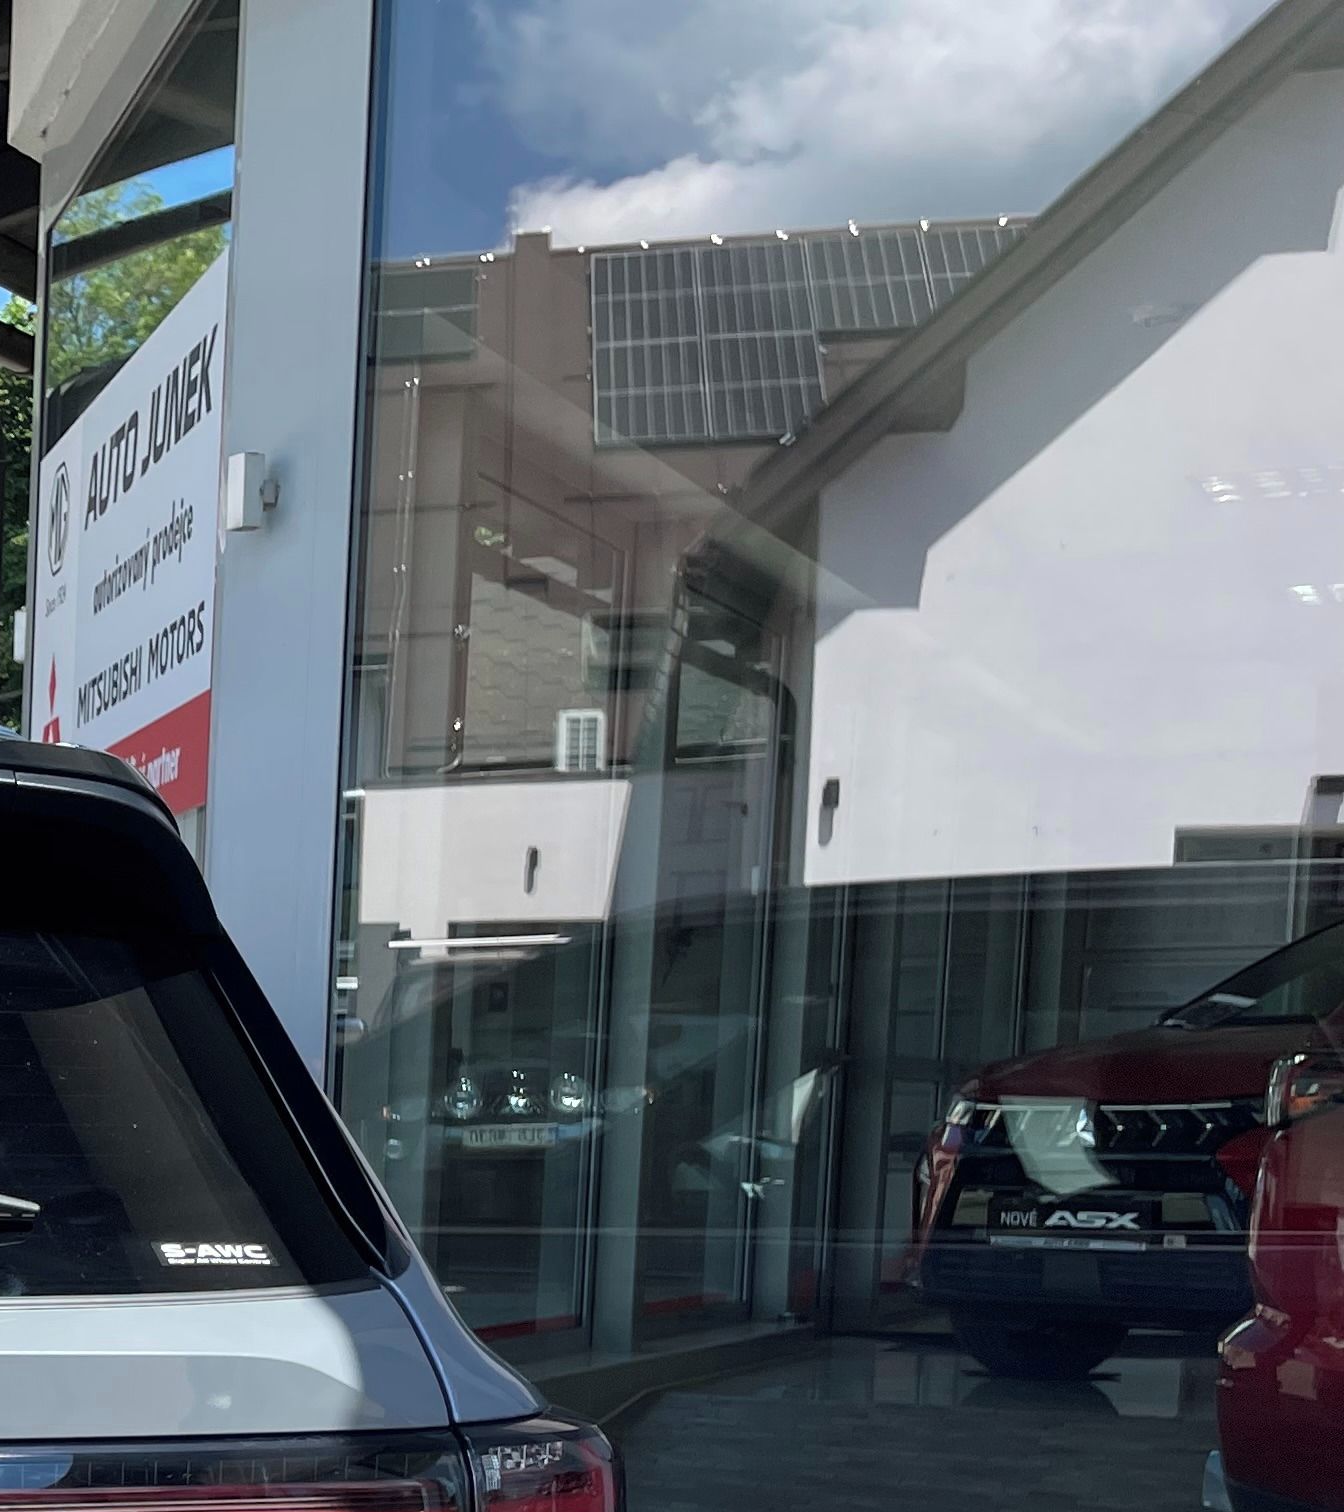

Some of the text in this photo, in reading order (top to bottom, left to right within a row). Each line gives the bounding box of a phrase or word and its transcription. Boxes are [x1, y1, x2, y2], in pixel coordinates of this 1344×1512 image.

[85, 323, 218, 531] AUTO JUNEK
[151, 498, 193, 585] prodejce
[77, 600, 205, 729] MITSUBISHI MOTORS
[160, 1243, 268, 1259] S-AWC
[1000, 1208, 1140, 1230] NOVÉ ASX
